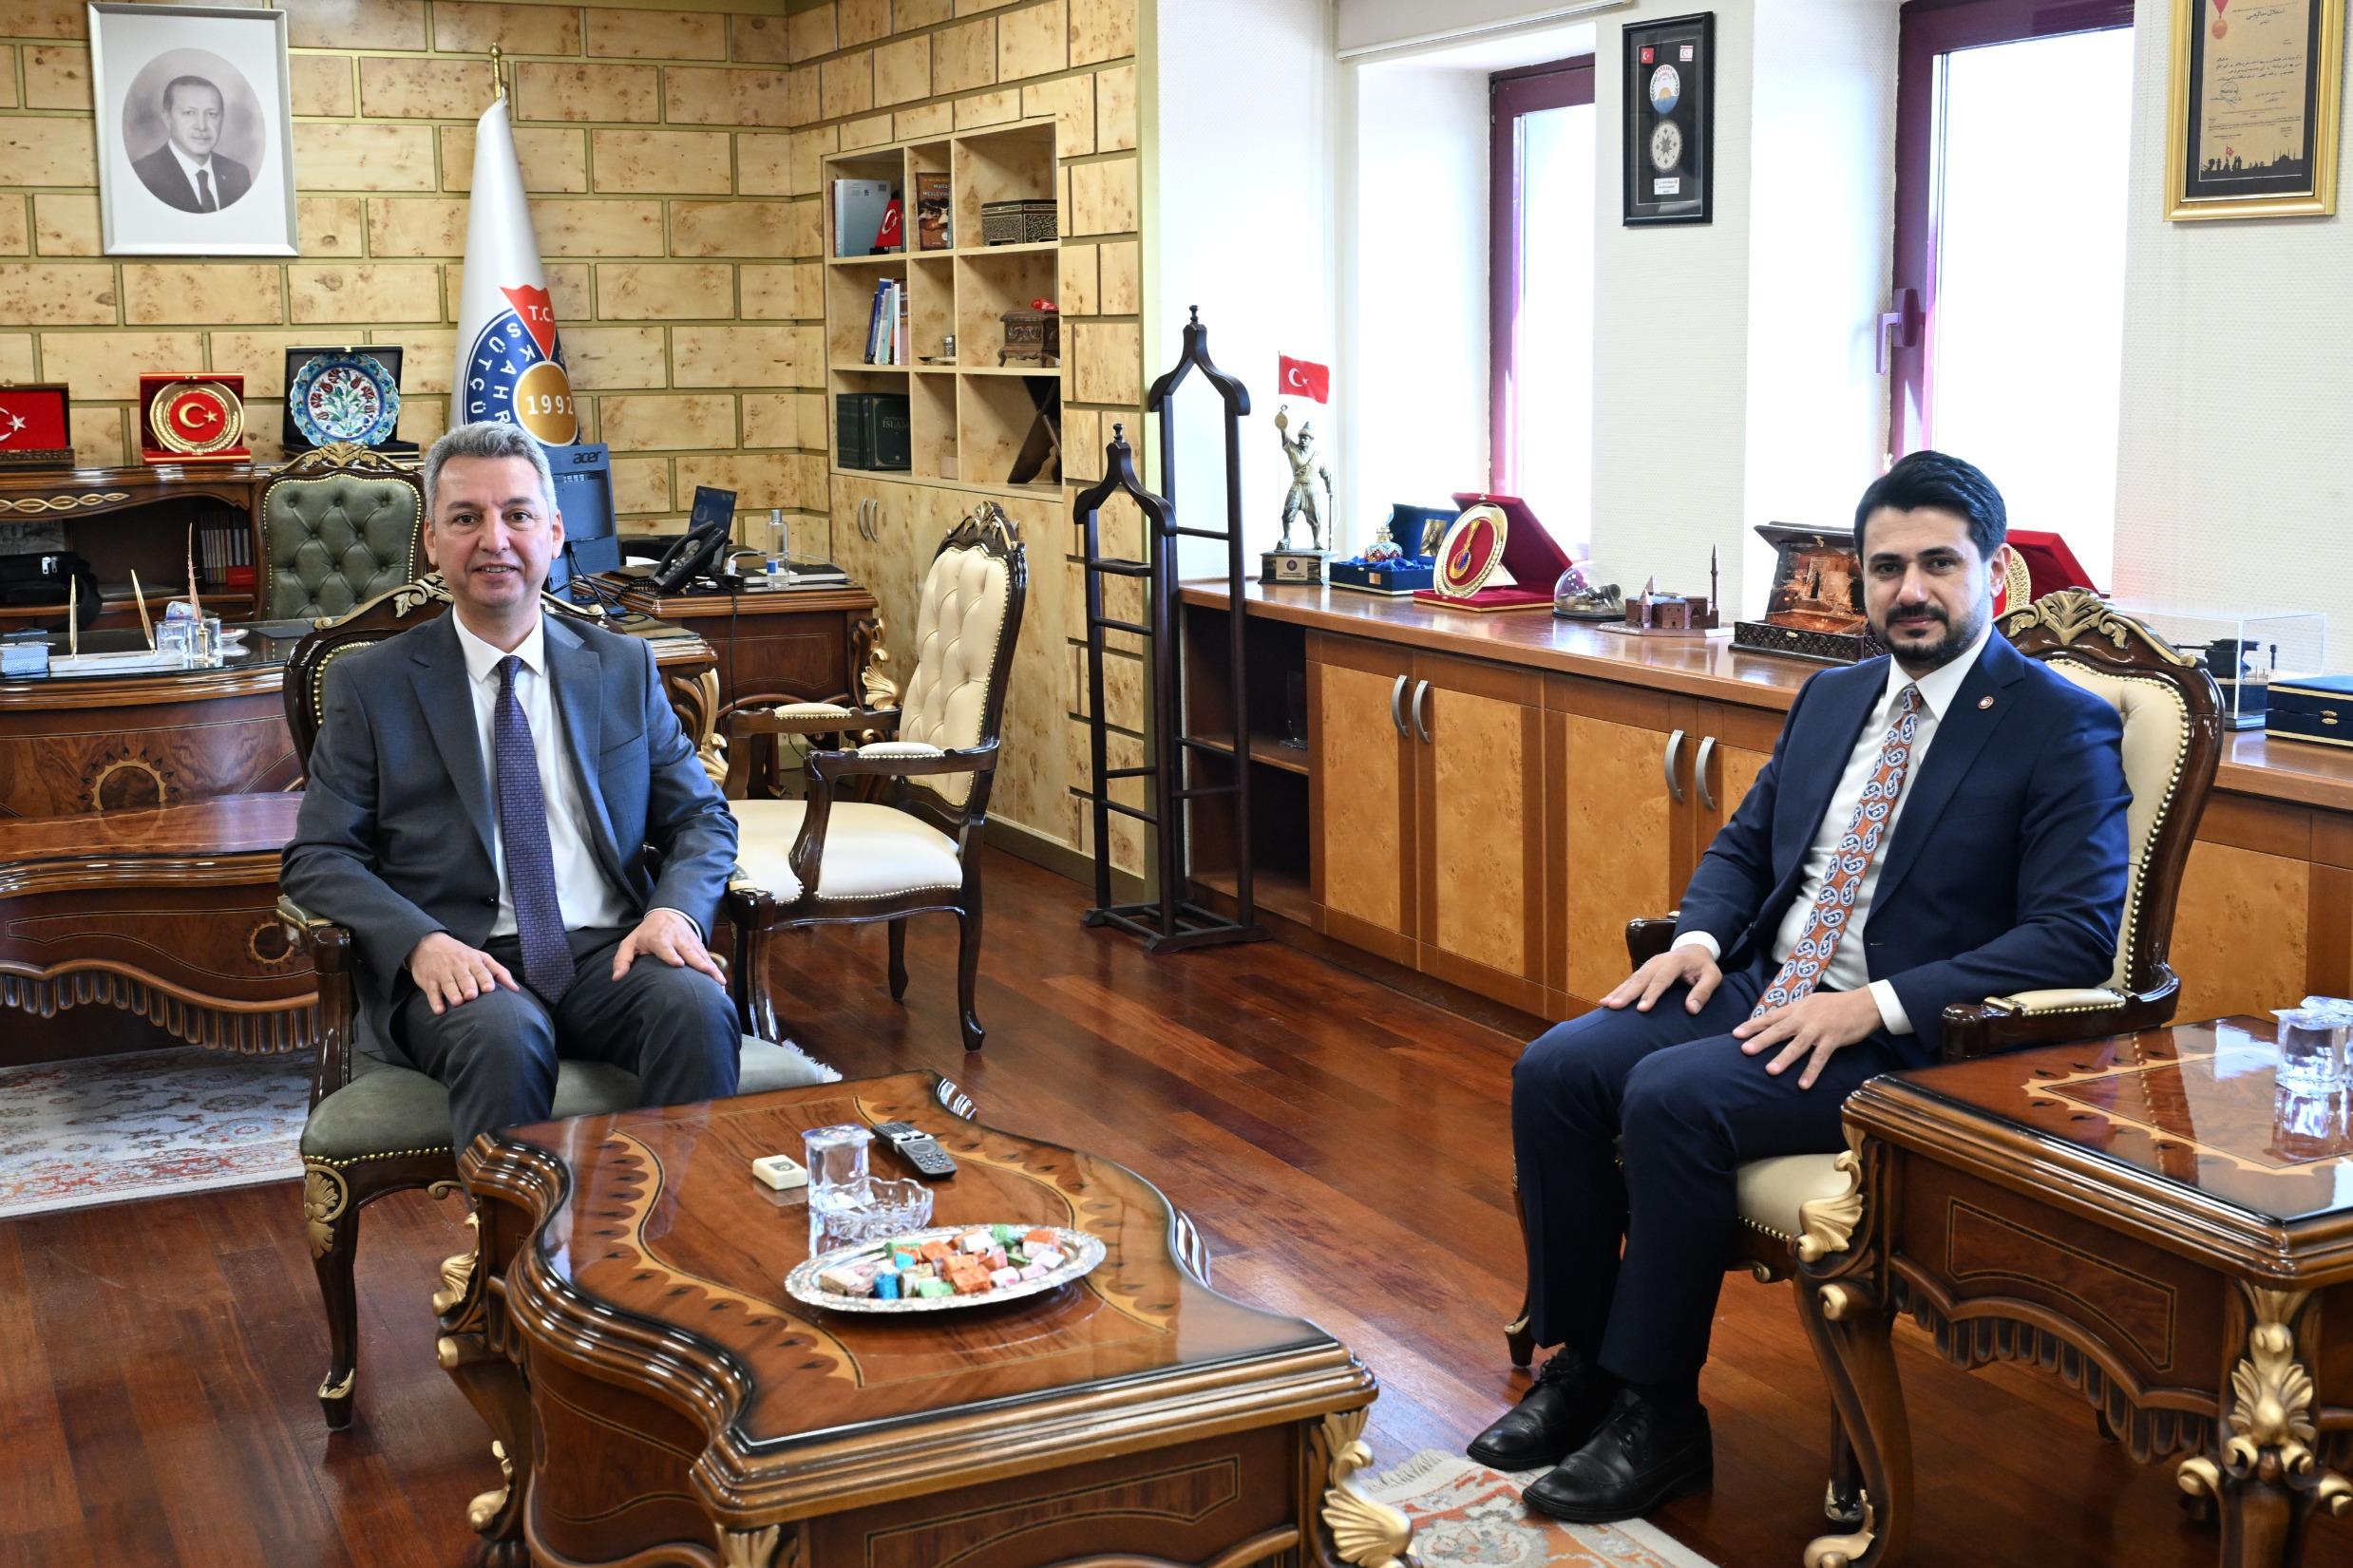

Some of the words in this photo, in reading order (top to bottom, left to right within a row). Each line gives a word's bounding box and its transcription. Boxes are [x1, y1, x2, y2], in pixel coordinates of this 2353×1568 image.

[527, 305, 554, 323] T.C.
[492, 344, 536, 424] KAHR
[526, 395, 574, 415] 1992
[573, 450, 602, 464] acer
